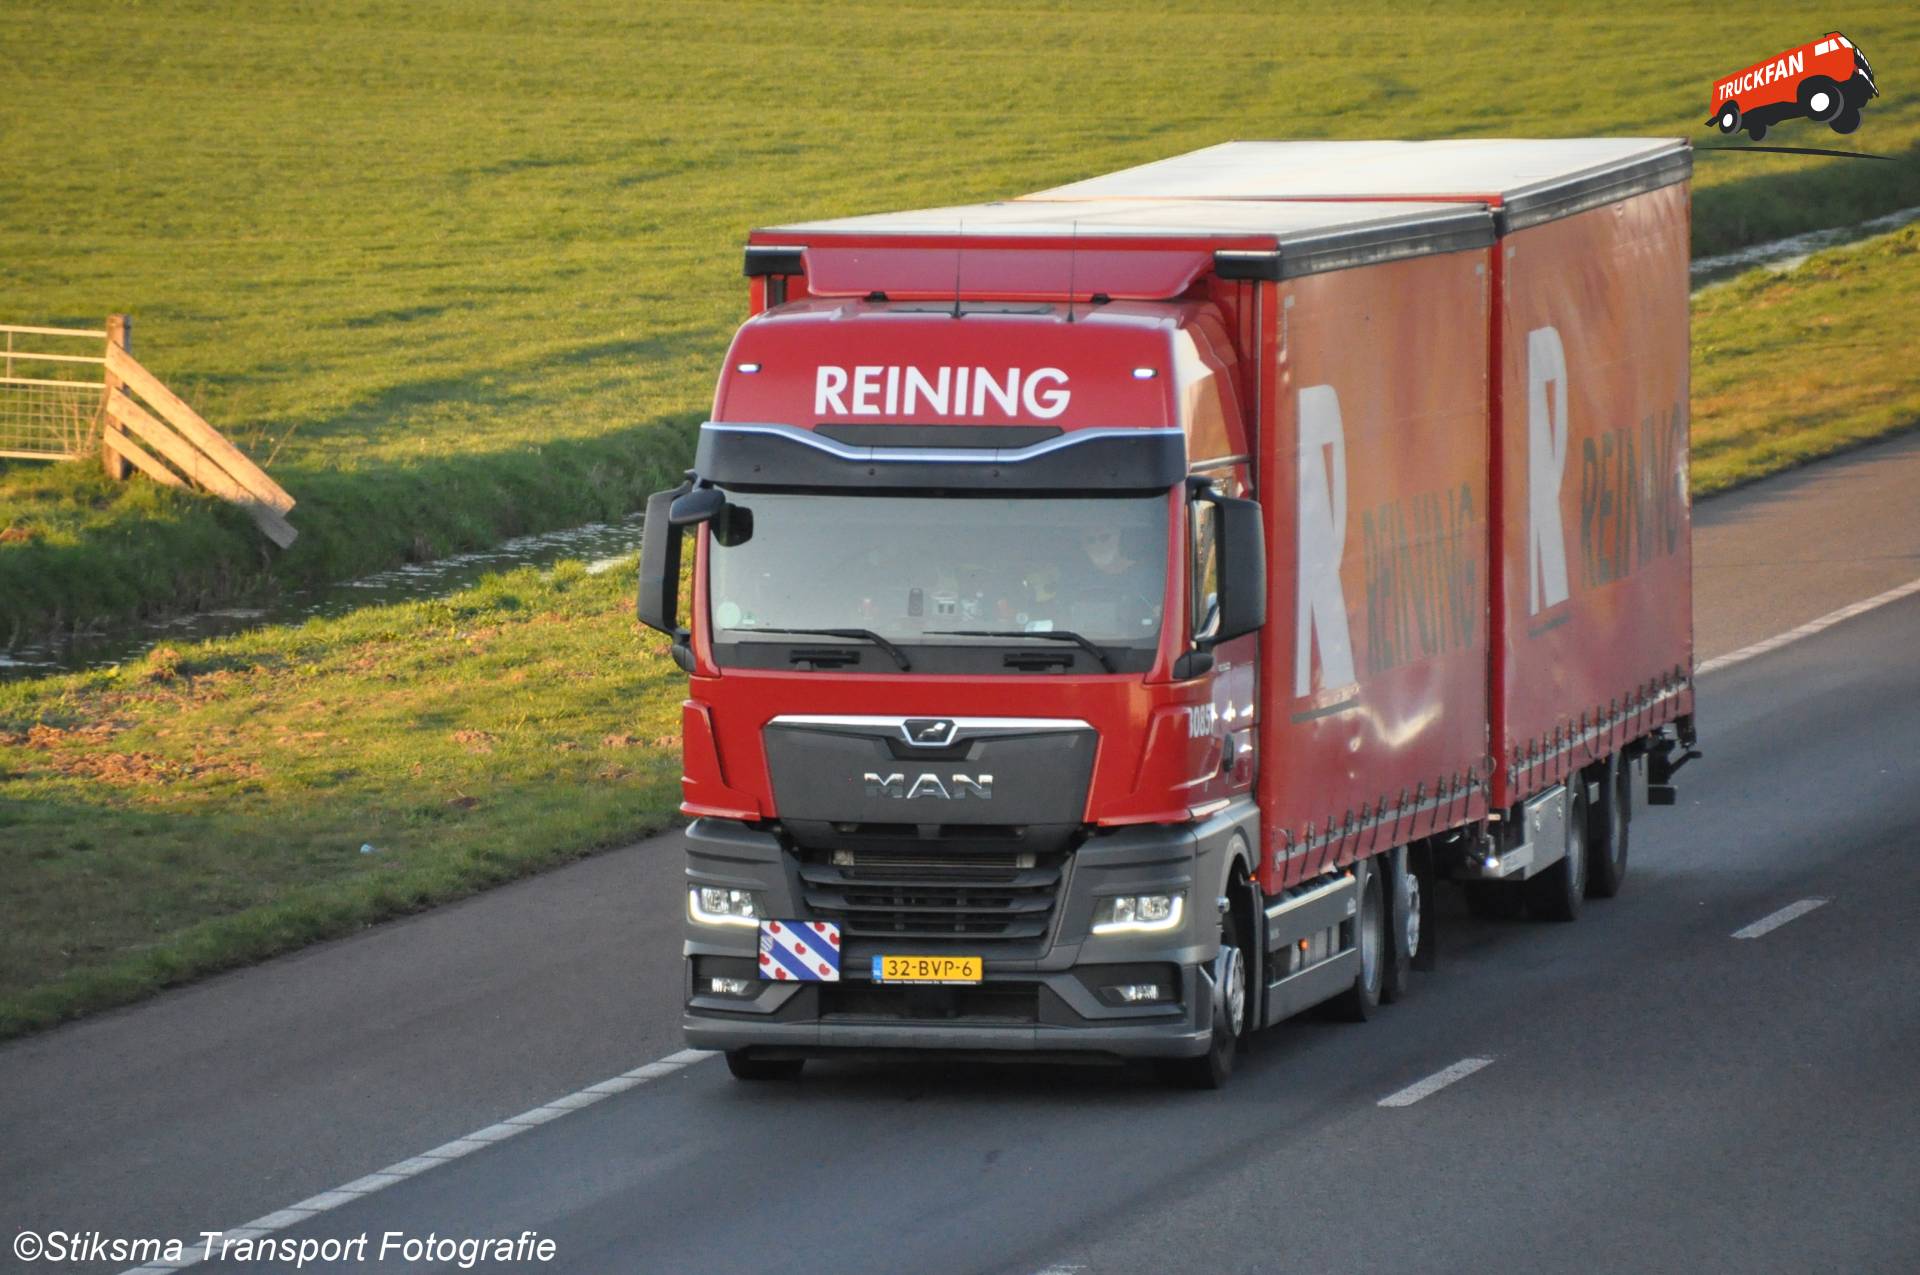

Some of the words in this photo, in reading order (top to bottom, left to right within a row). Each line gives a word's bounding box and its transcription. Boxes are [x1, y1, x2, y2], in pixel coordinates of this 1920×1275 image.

[814, 365, 1071, 419] REINING
[1528, 326, 1571, 617] R
[1296, 384, 1357, 698] R
[1362, 482, 1475, 677] REINING
[1580, 401, 1684, 592] REINING
[863, 772, 993, 800] MAN
[888, 959, 973, 977] 32-BVP-6
